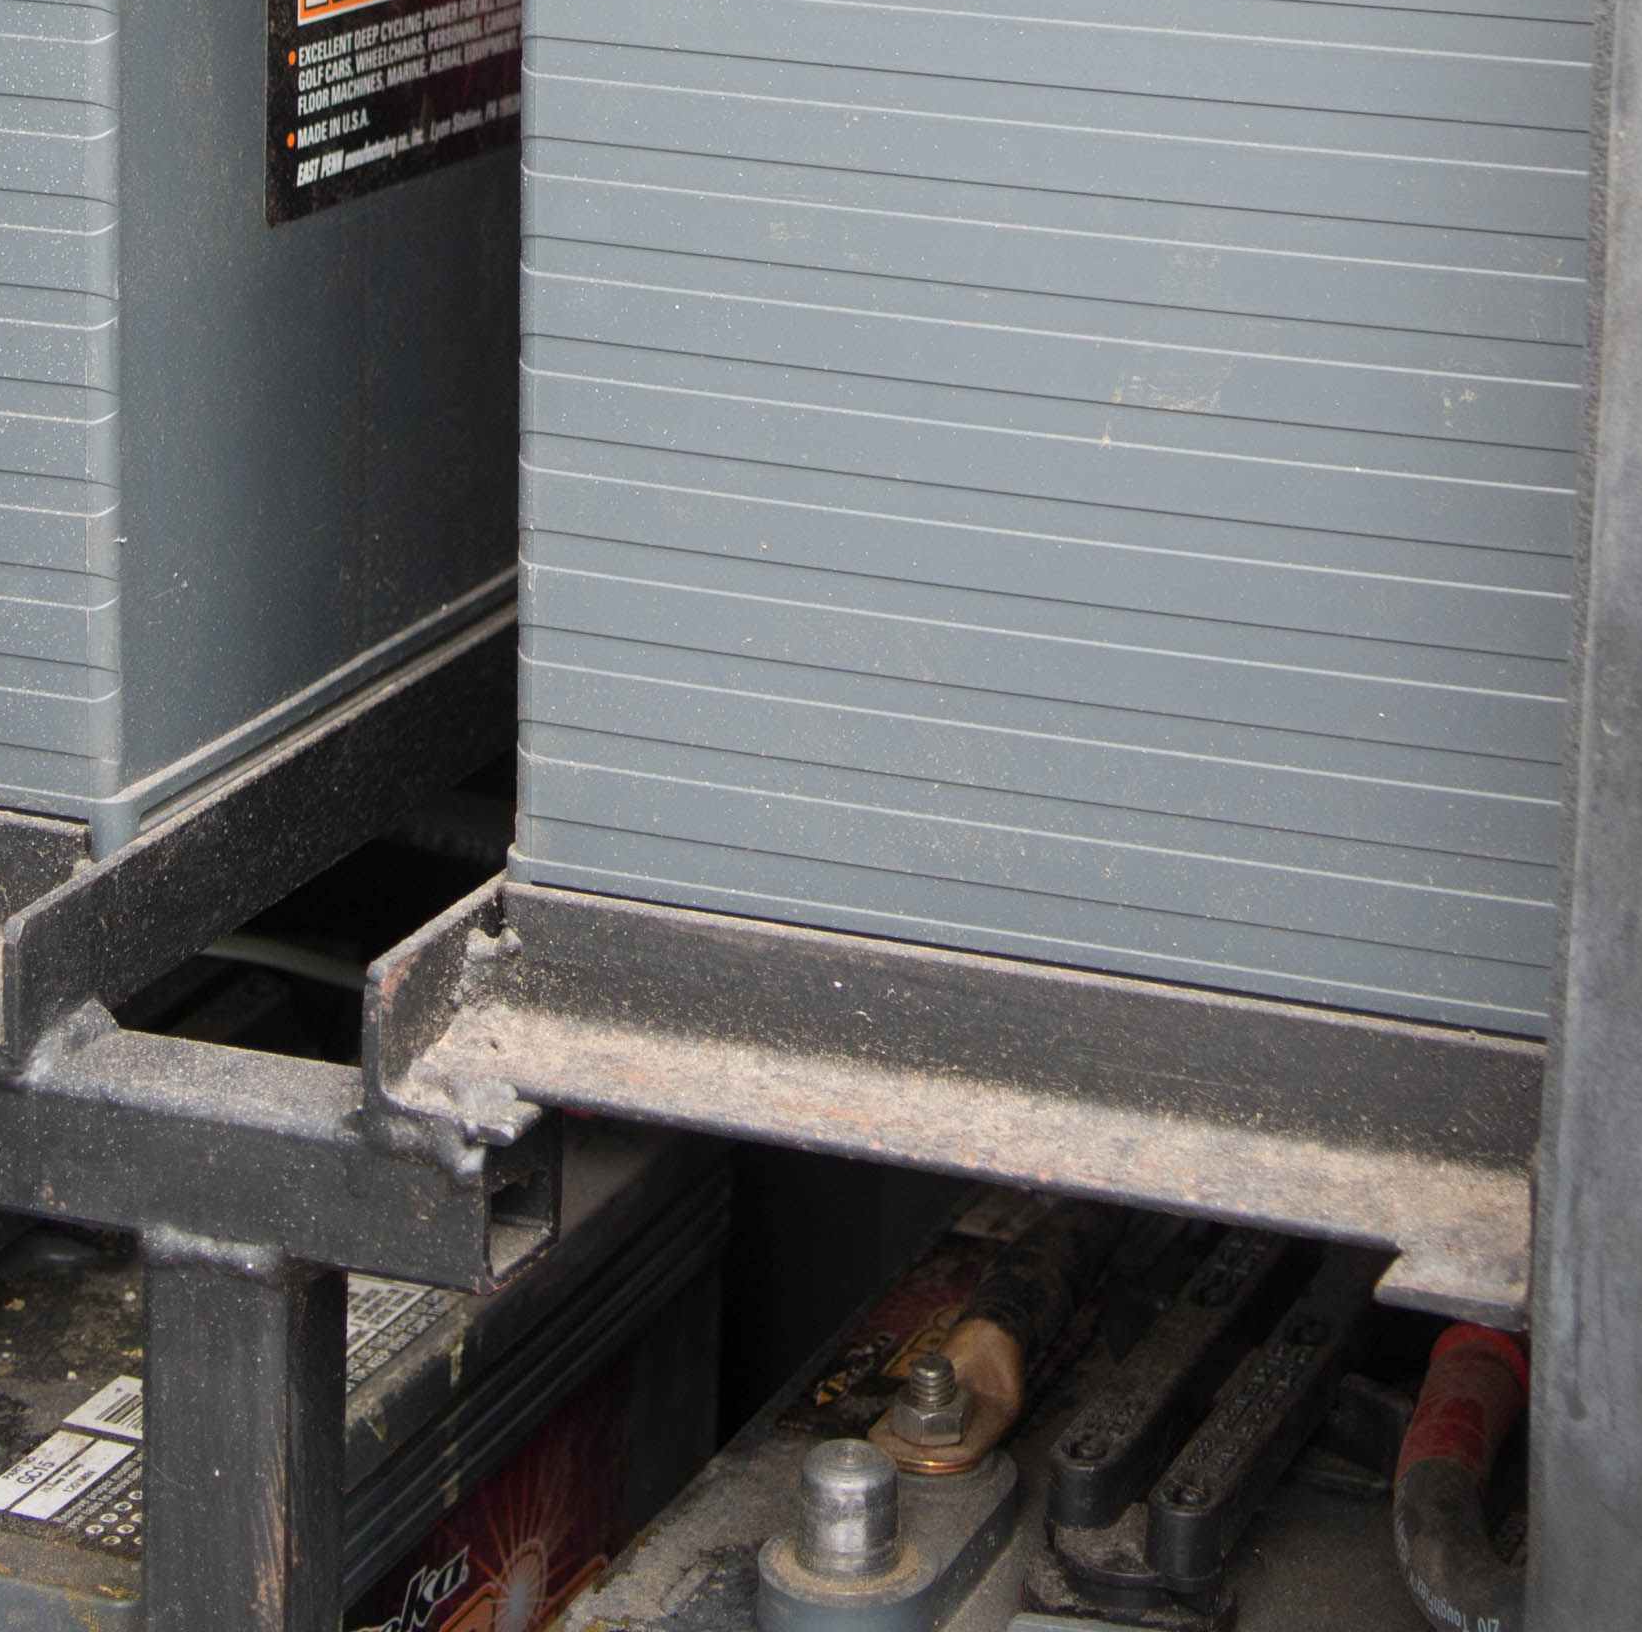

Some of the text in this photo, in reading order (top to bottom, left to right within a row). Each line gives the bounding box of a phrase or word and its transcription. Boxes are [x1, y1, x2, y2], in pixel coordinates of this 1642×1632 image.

[298, 32, 353, 67] EXCELLENT
[354, 26, 379, 50] DEEP
[380, 13, 423, 39] CYCLING
[423, 2, 458, 29] POWER
[298, 68, 324, 92] GOLF
[325, 58, 354, 87] CARS,
[298, 89, 329, 116] FLOOR
[331, 71, 385, 107] MACHINES,
[429, 48, 463, 73] AERIAL
[298, 107, 370, 149] MADE IN U.S.A.
[296, 158, 320, 188] EAST
[320, 149, 345, 179] PENN
[17, 1460, 55, 1483] GC15
